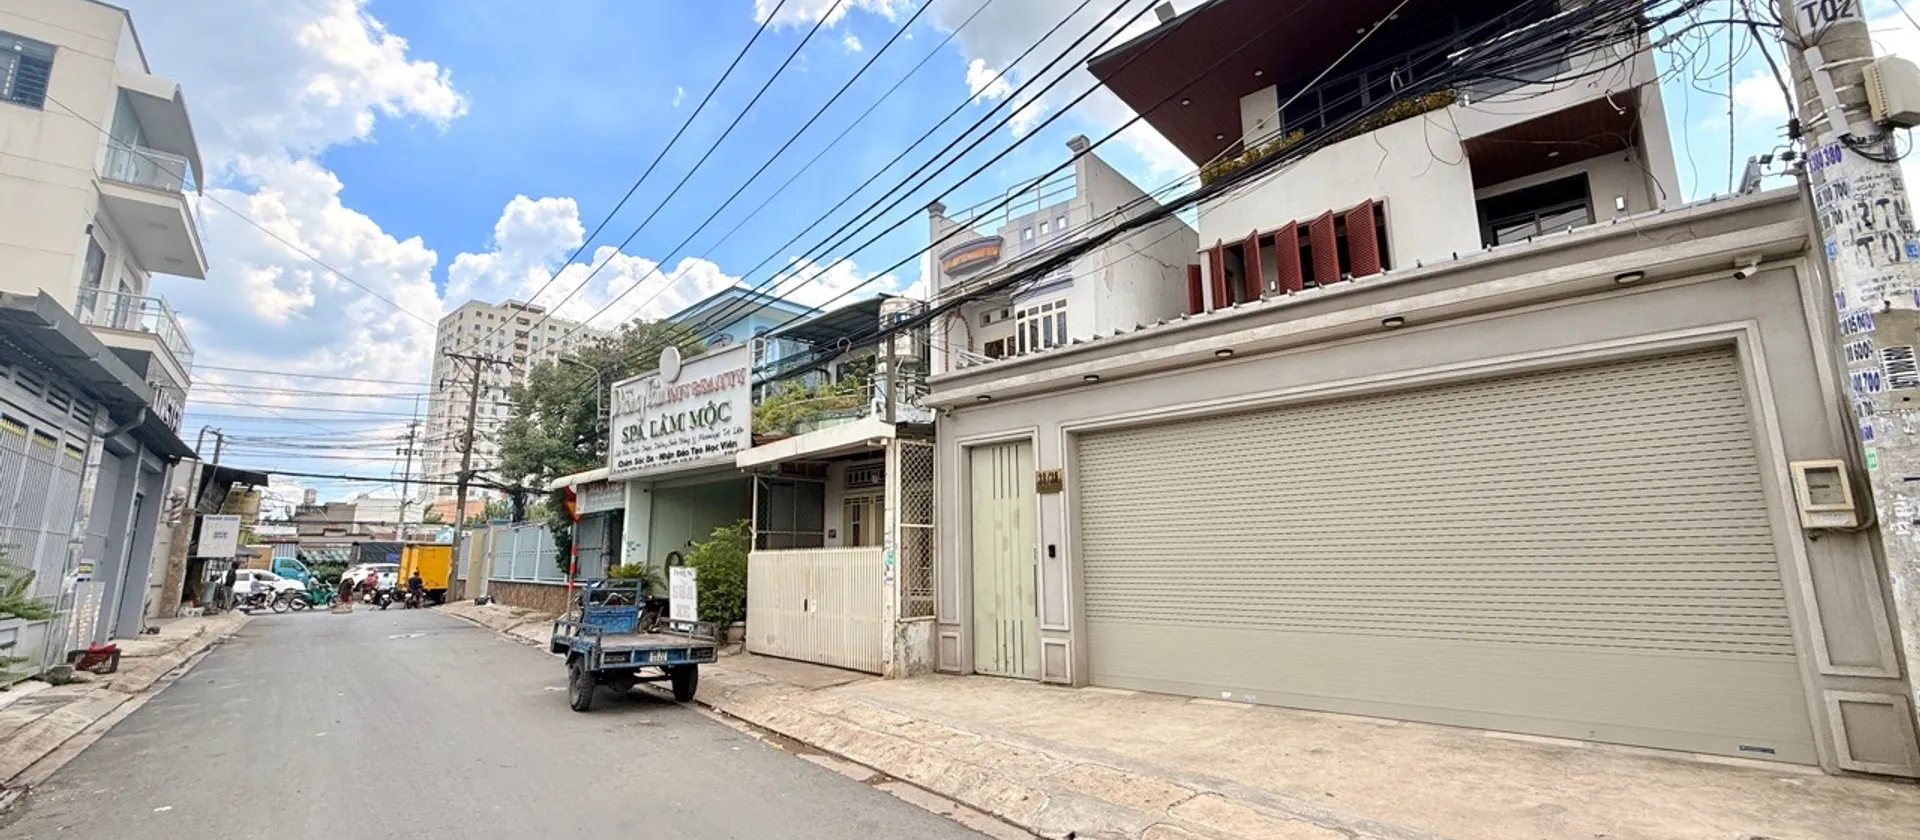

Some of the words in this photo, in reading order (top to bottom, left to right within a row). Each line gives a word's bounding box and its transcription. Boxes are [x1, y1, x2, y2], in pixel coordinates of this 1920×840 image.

[621, 424, 647, 445] SPA
[650, 413, 685, 438] LÂM
[689, 400, 732, 430] MỘC
